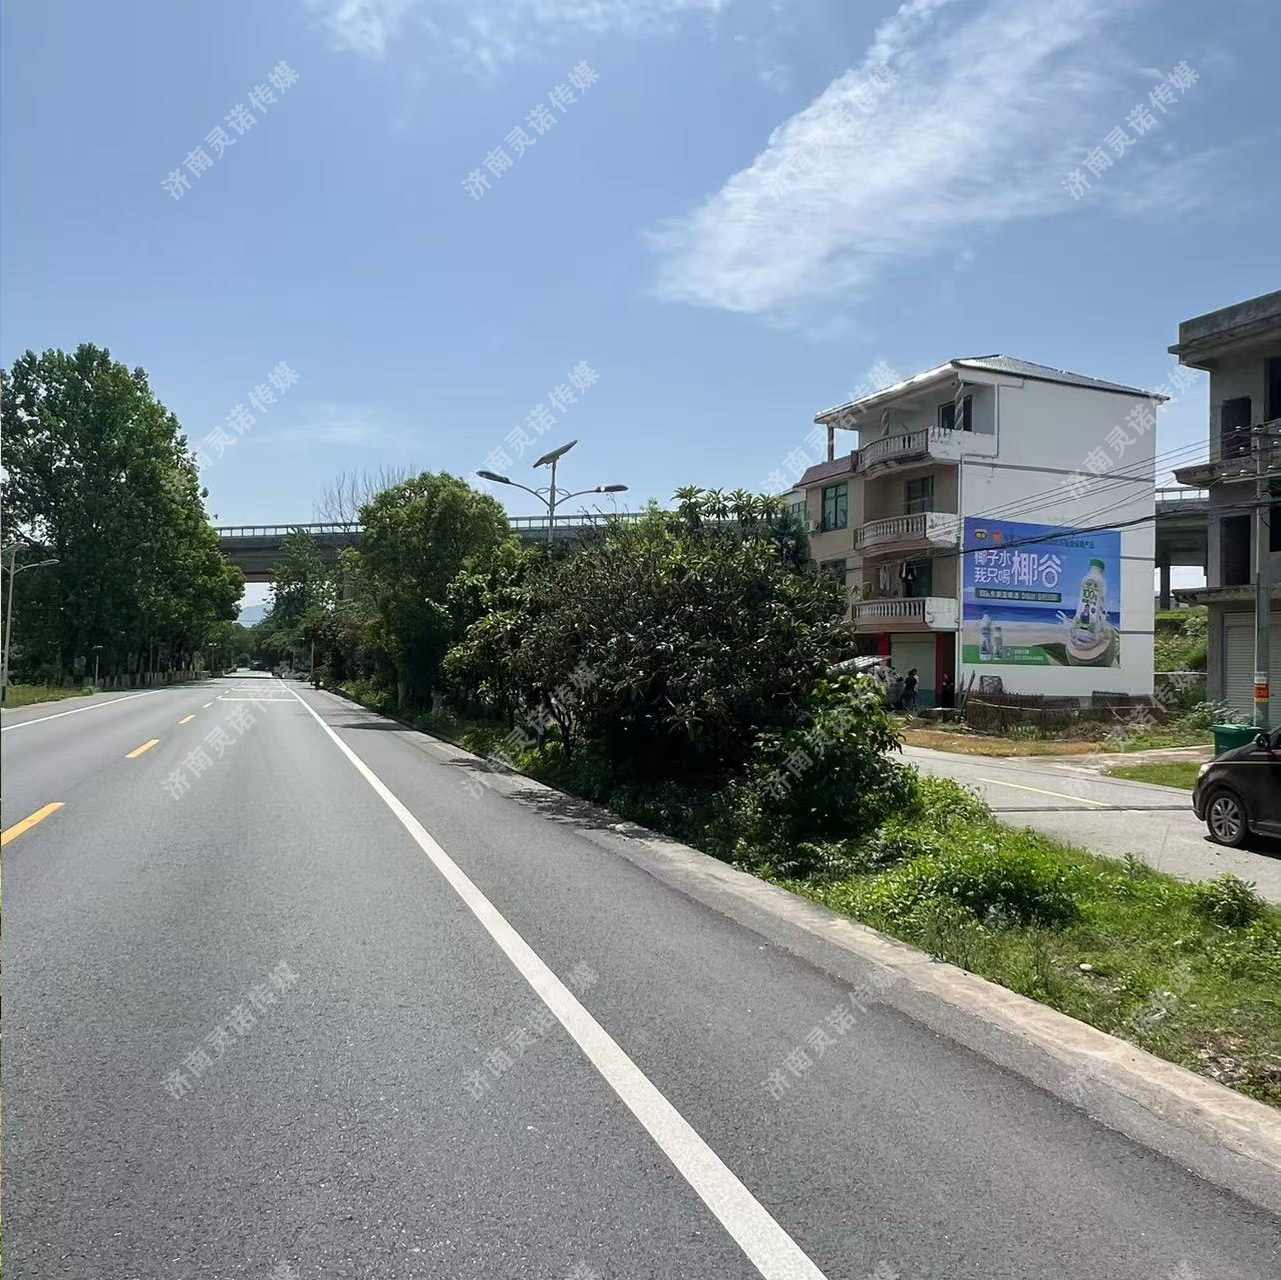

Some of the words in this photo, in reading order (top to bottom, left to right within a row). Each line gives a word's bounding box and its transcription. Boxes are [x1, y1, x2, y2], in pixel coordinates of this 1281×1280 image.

[974, 550, 1012, 567] 椰子水
[974, 567, 1011, 585] 我只喝
[1011, 551, 1063, 588] 椰谷
